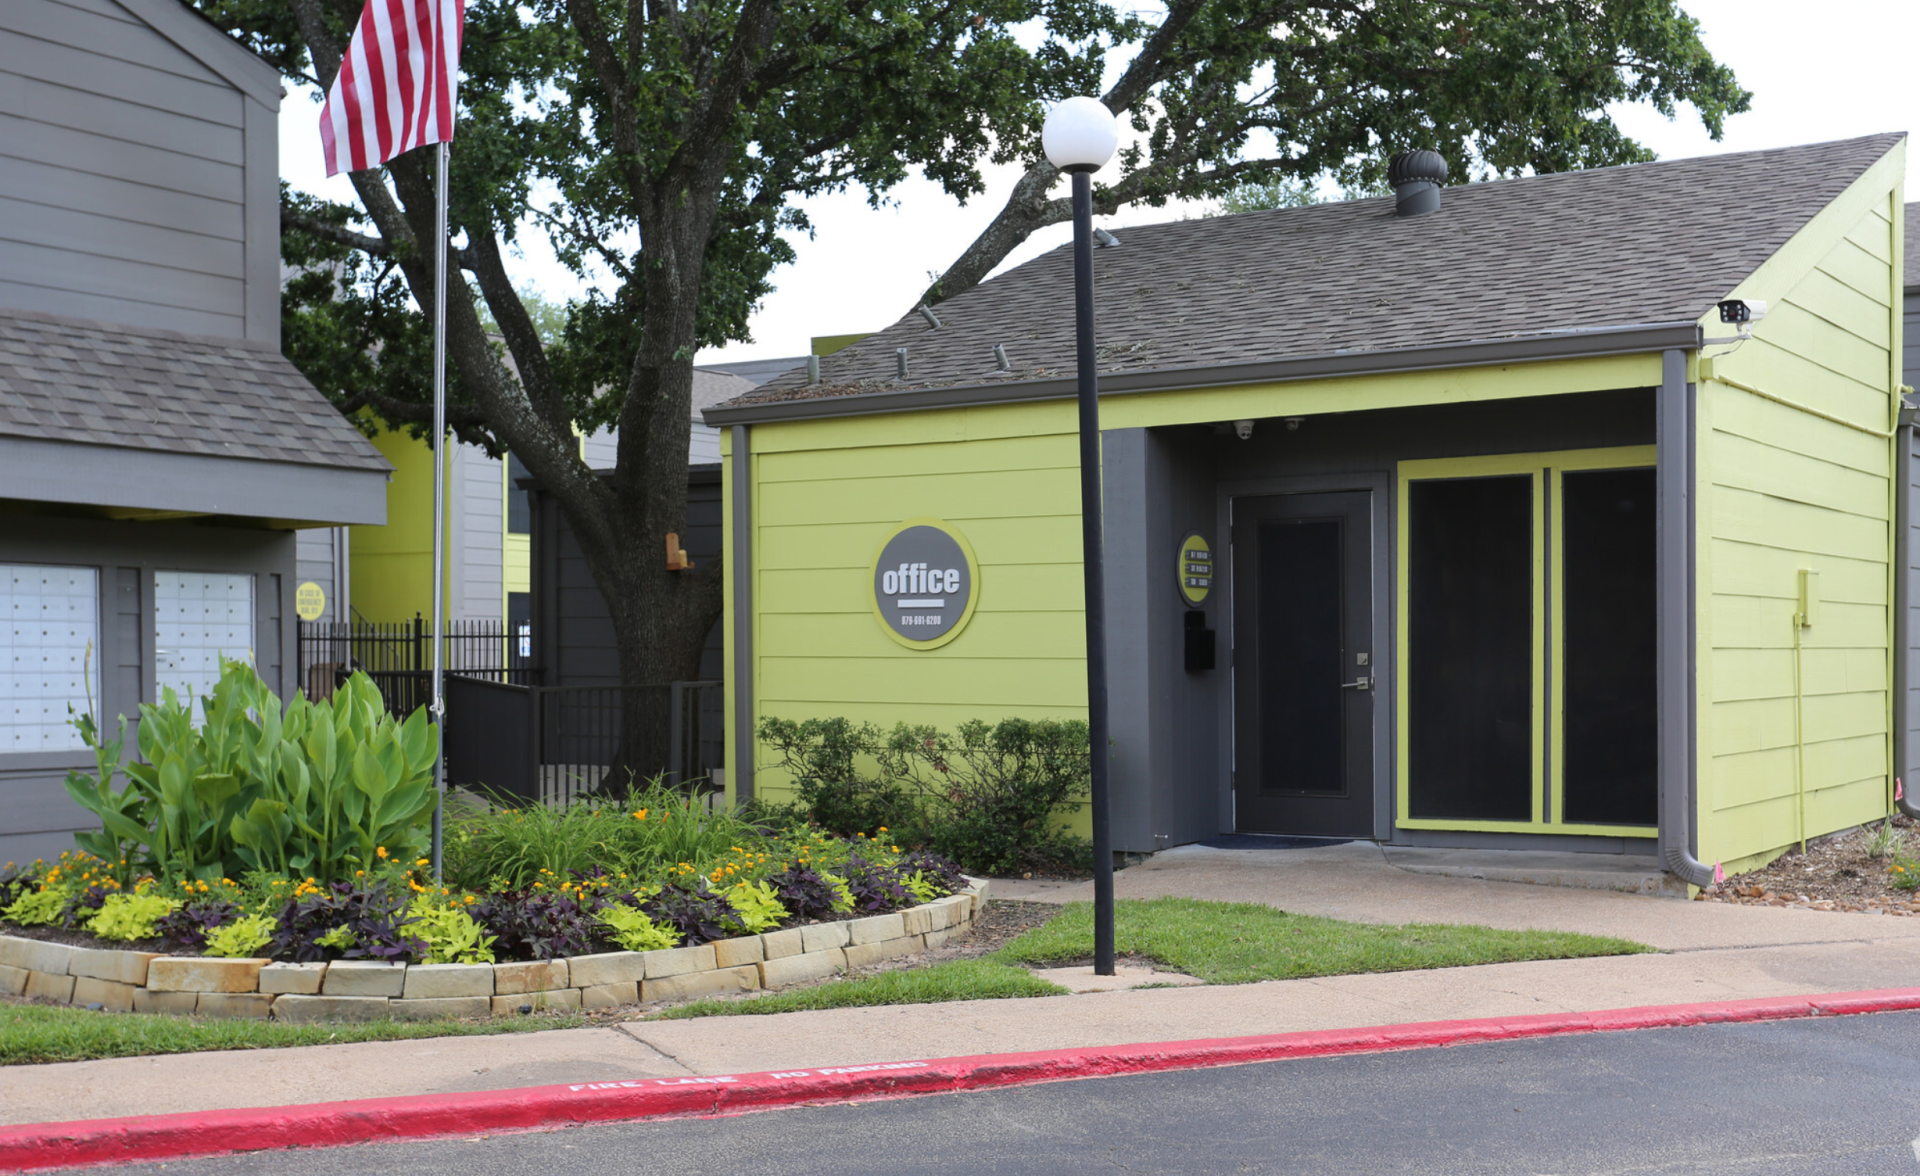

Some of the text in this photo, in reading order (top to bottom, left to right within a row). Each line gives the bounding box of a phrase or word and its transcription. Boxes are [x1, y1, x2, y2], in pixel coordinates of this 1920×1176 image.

[883, 563, 959, 594] office
[569, 1061, 930, 1091] FIRE LANE NO PARKING
